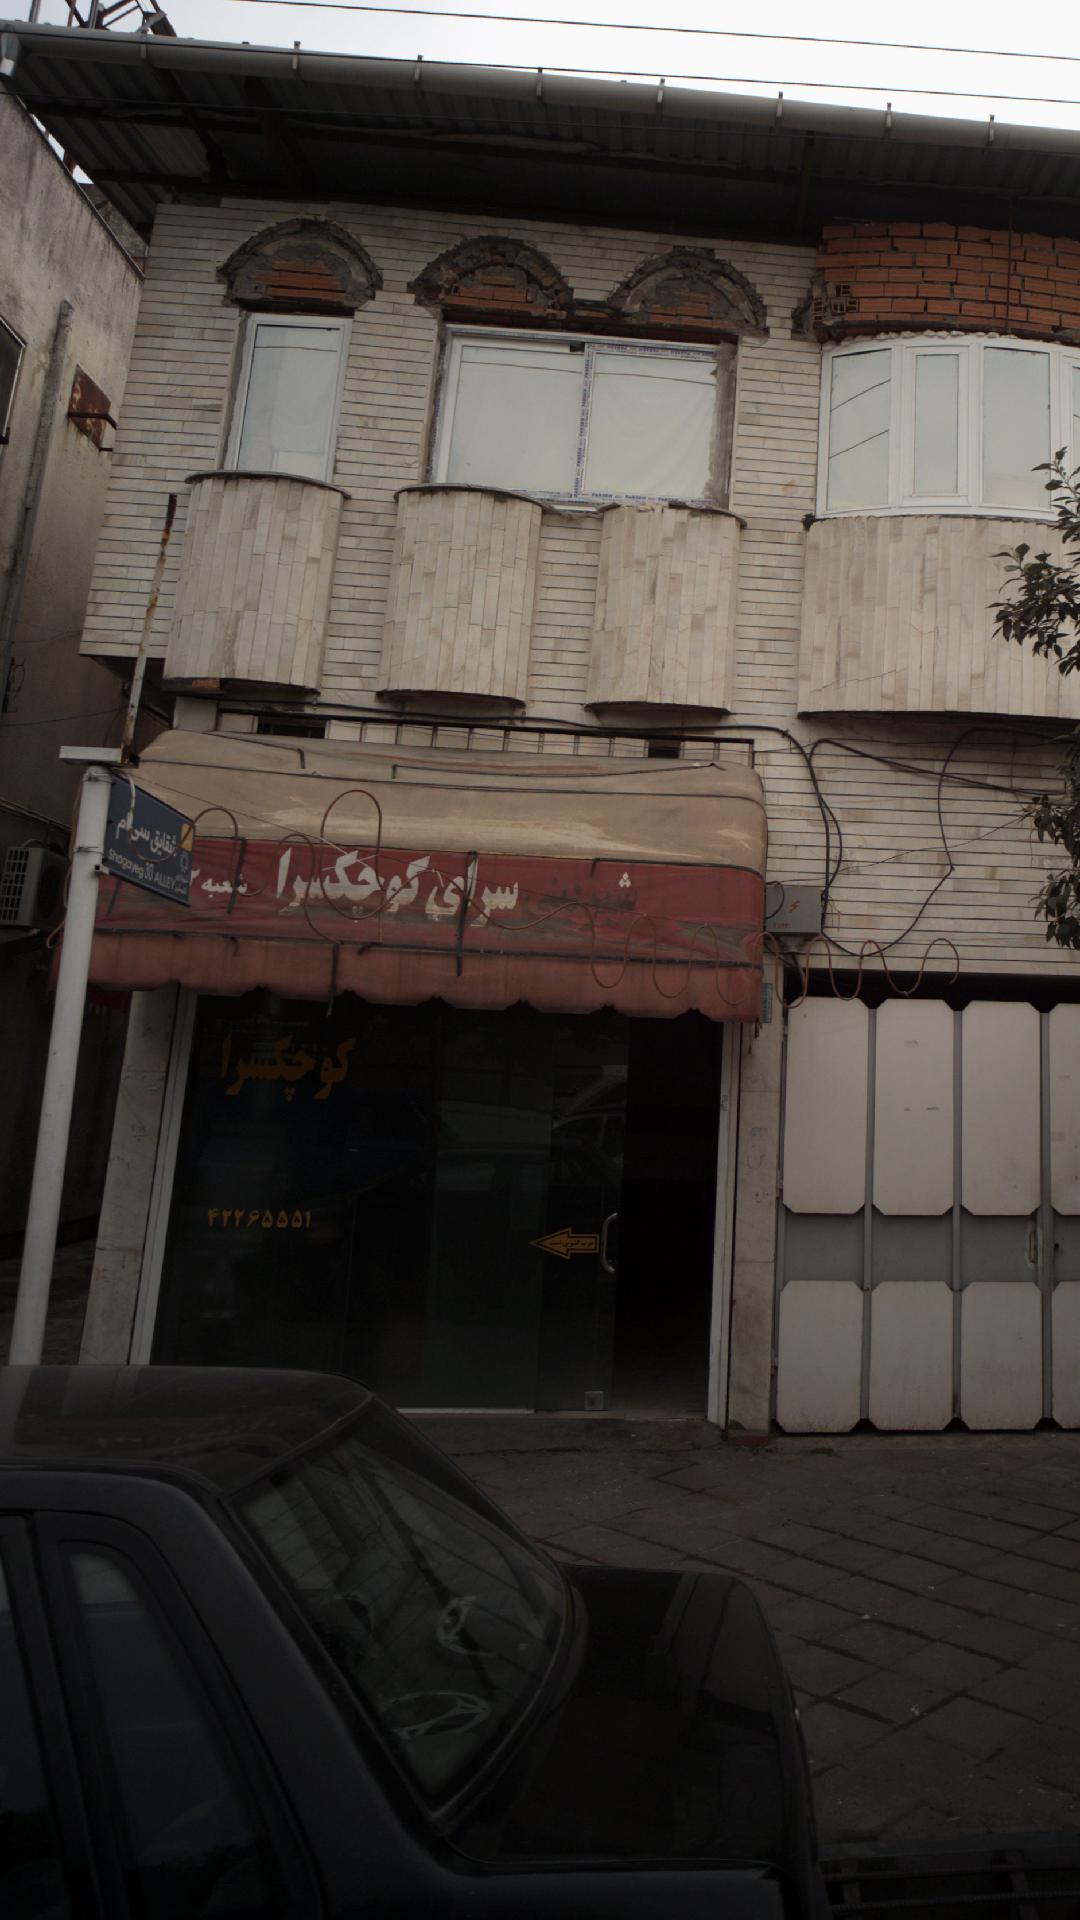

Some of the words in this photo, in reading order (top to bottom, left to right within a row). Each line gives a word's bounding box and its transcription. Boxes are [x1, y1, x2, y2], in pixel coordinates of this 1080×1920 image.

[155, 871, 176, 889] ALLEY
[201, 873, 248, 899] شعبه
[207, 1206, 313, 1230] ۴۲۲۶۵۵۵۱
